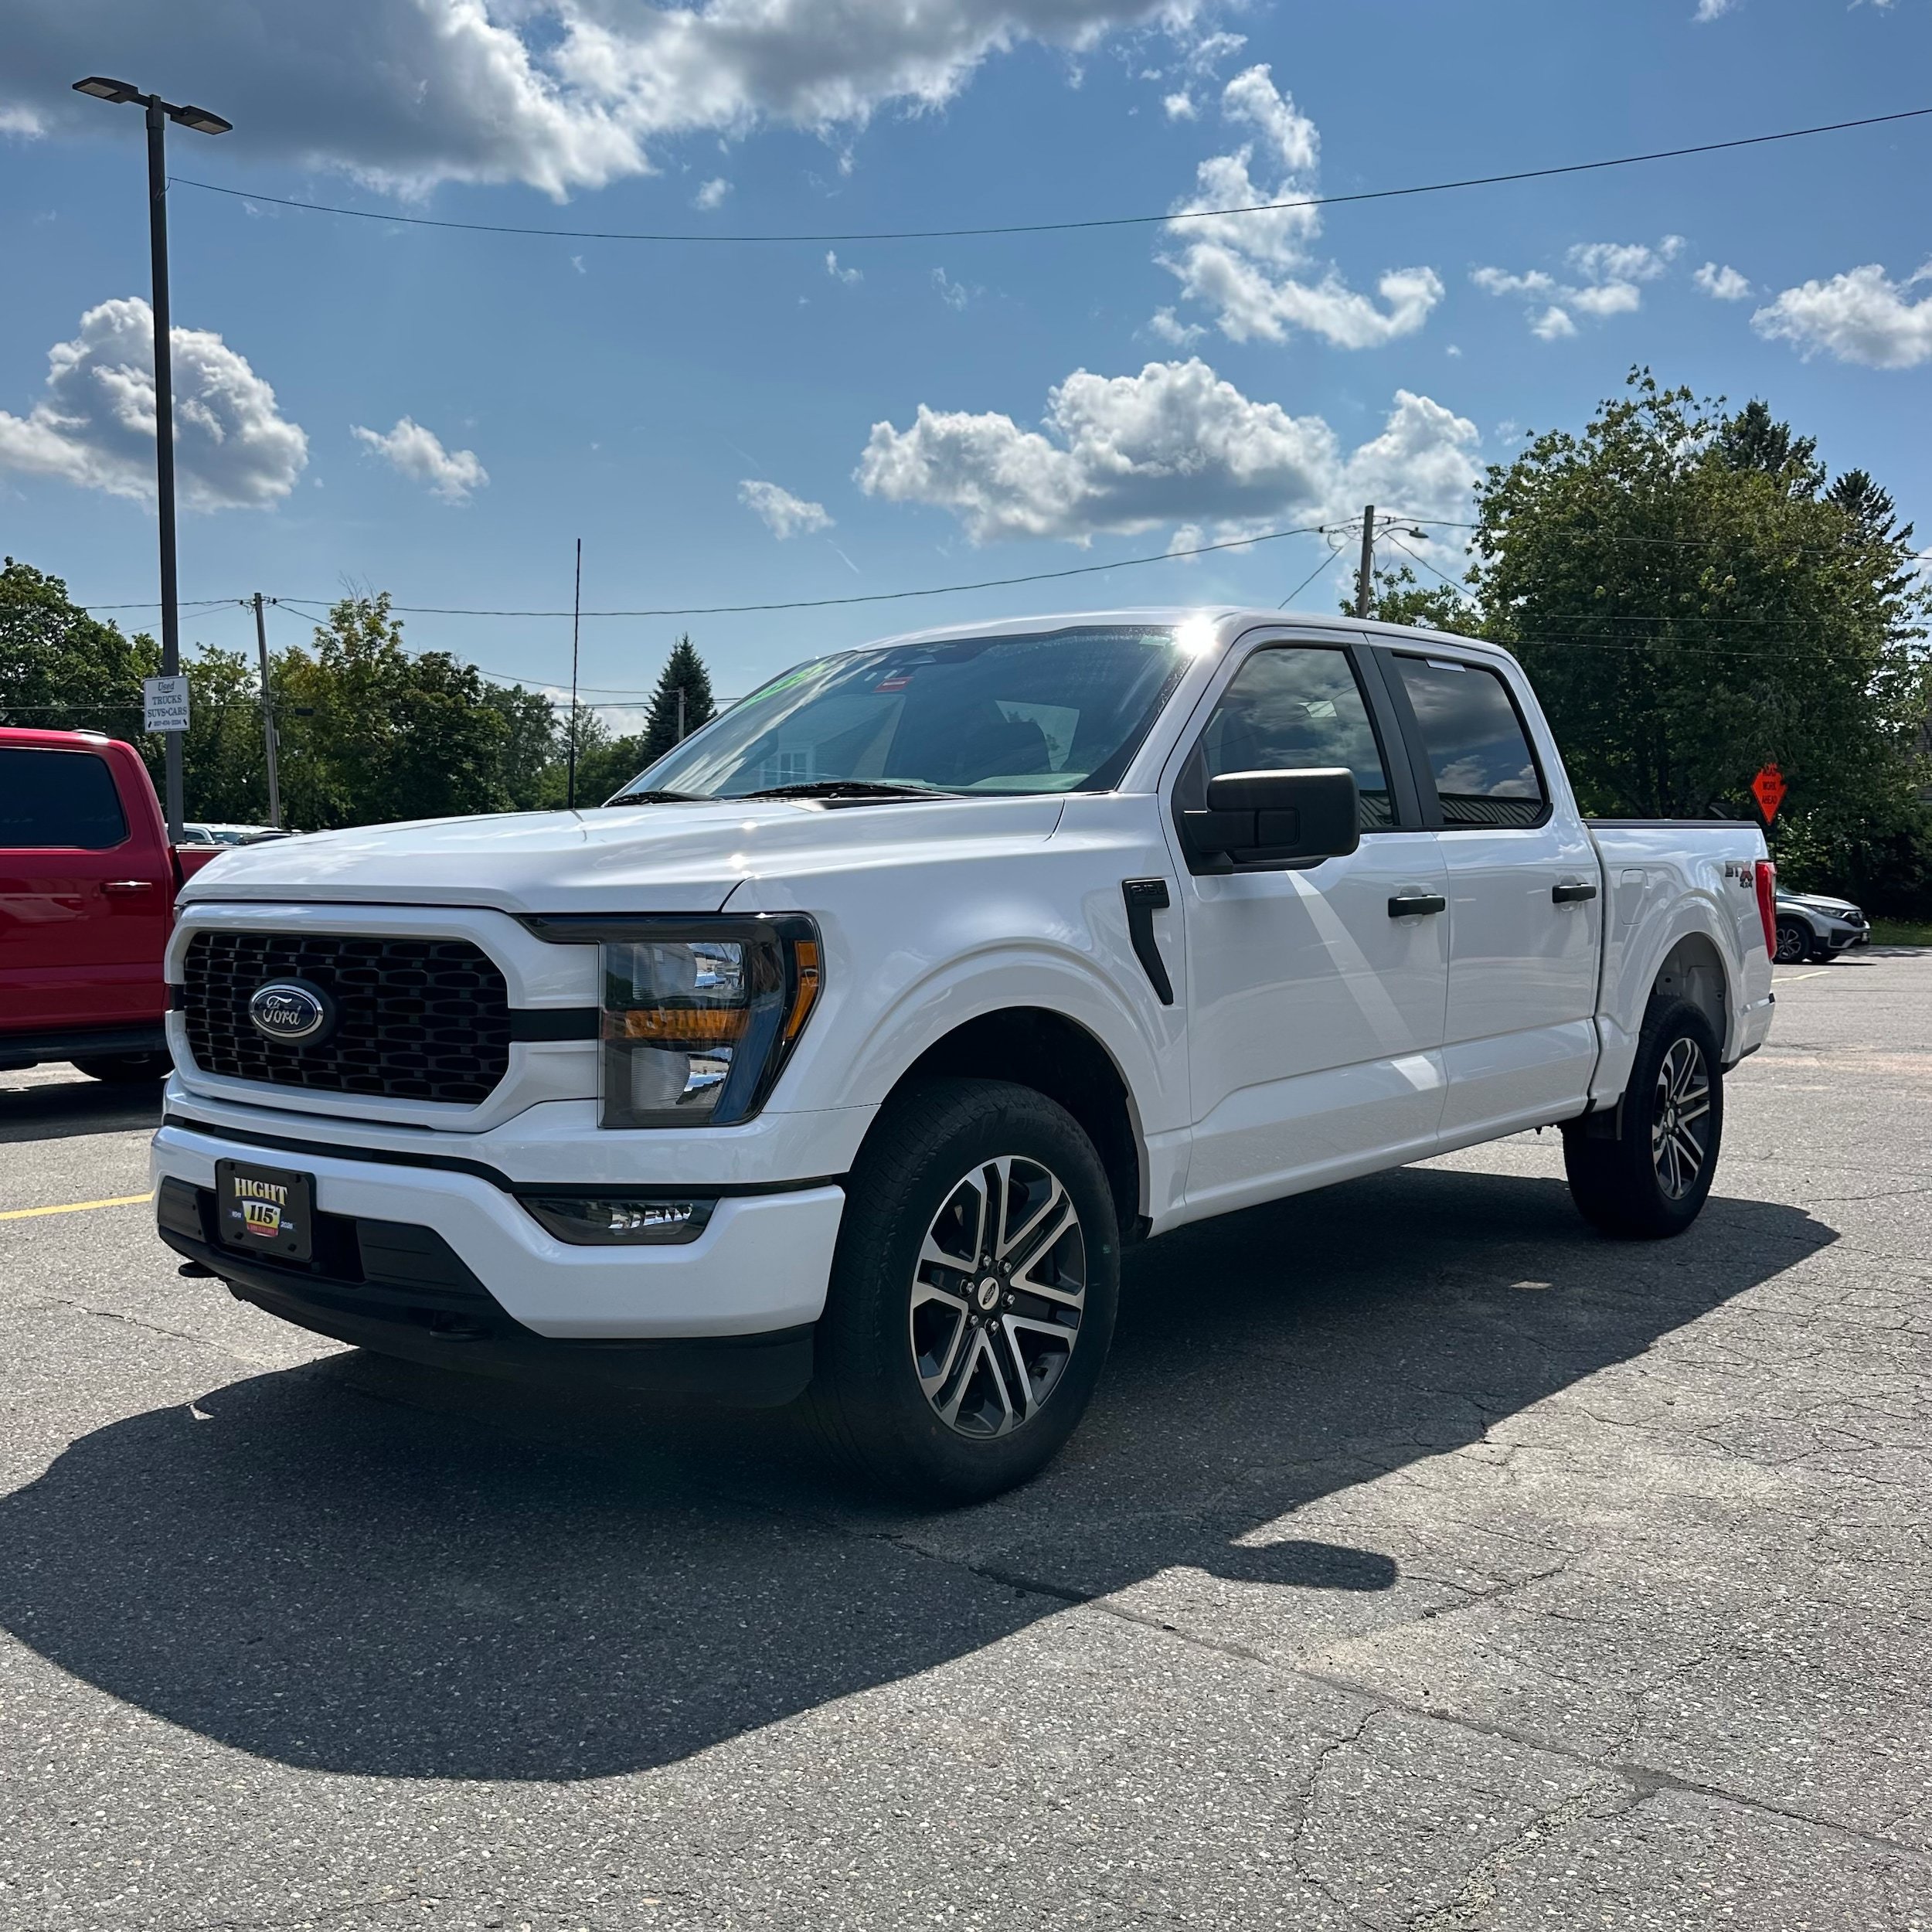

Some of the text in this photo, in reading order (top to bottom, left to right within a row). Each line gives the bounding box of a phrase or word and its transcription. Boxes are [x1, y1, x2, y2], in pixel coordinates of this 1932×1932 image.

[158, 681, 175, 692] Used
[152, 695, 182, 706] TRUCKS
[263, 995, 302, 1026] Ford
[234, 1177, 288, 1206] HIGHT
